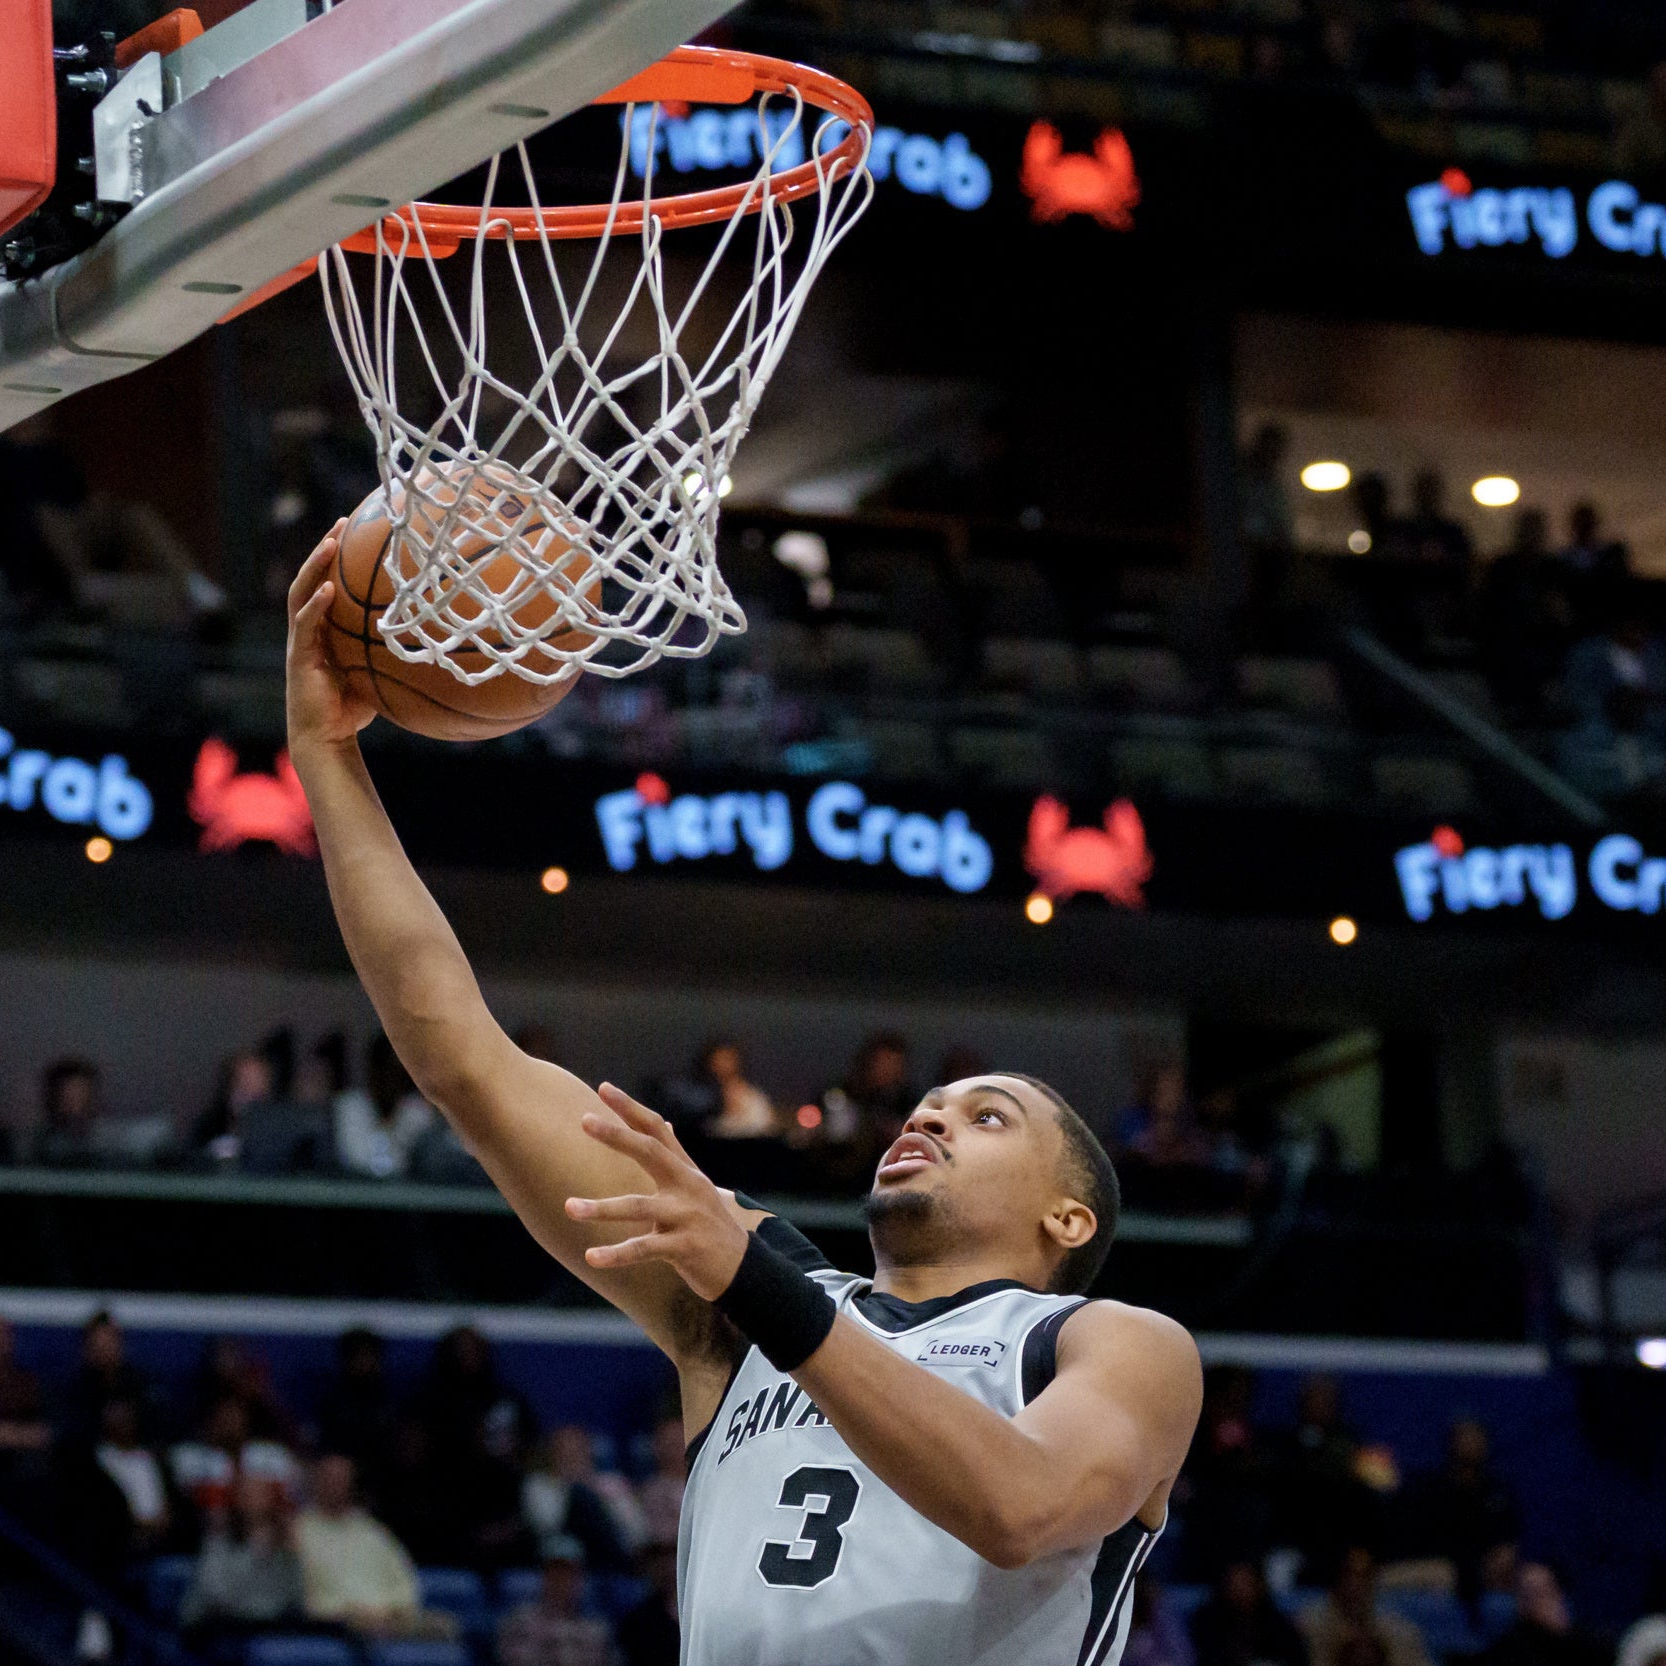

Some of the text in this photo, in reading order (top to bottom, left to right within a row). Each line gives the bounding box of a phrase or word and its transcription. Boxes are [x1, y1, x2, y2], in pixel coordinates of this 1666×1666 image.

[621, 102, 805, 178] Fiery
[1407, 171, 1577, 258] Fiery
[595, 774, 993, 893] Fiery Crab
[1394, 828, 1577, 921] Fiery
[929, 1342, 991, 1360] LEDGER
[716, 1381, 803, 1471] SAN
[755, 1463, 864, 1591] 3
